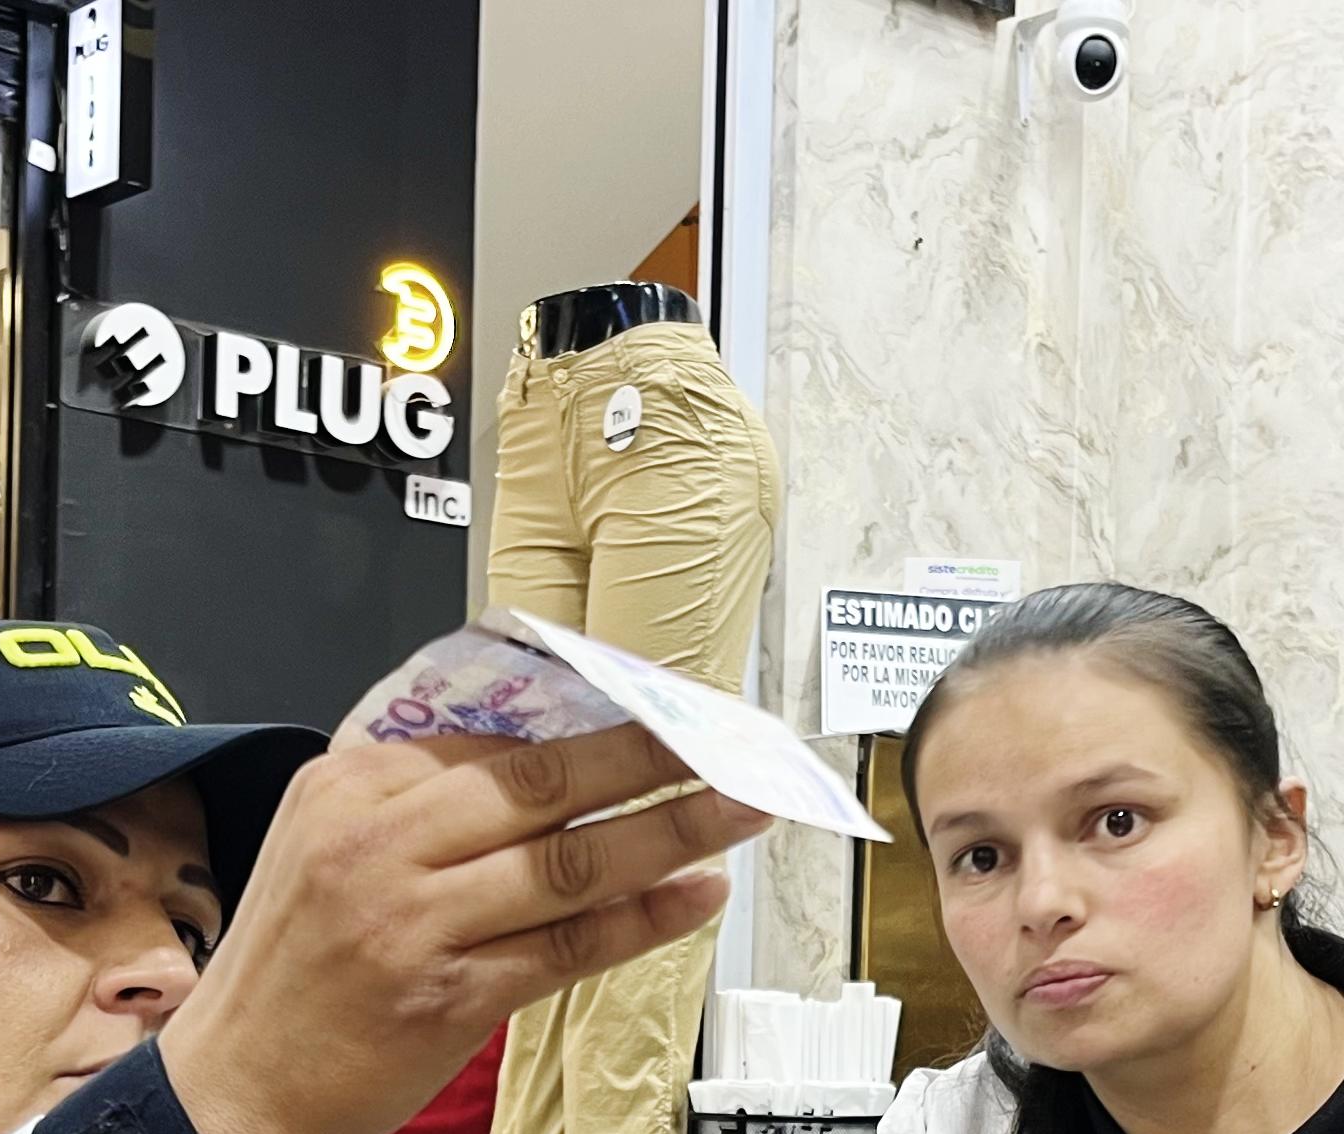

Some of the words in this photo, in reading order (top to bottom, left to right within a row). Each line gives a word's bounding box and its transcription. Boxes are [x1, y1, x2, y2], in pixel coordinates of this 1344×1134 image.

[214, 331, 455, 459] PLUG
[413, 482, 467, 520] inc.
[829, 597, 954, 633] ESTIMADO
[830, 641, 857, 661] POR
[862, 643, 905, 663] FAVOR
[842, 664, 869, 683] POR
[873, 667, 892, 685] LA
[871, 689, 918, 709] MAYOR
